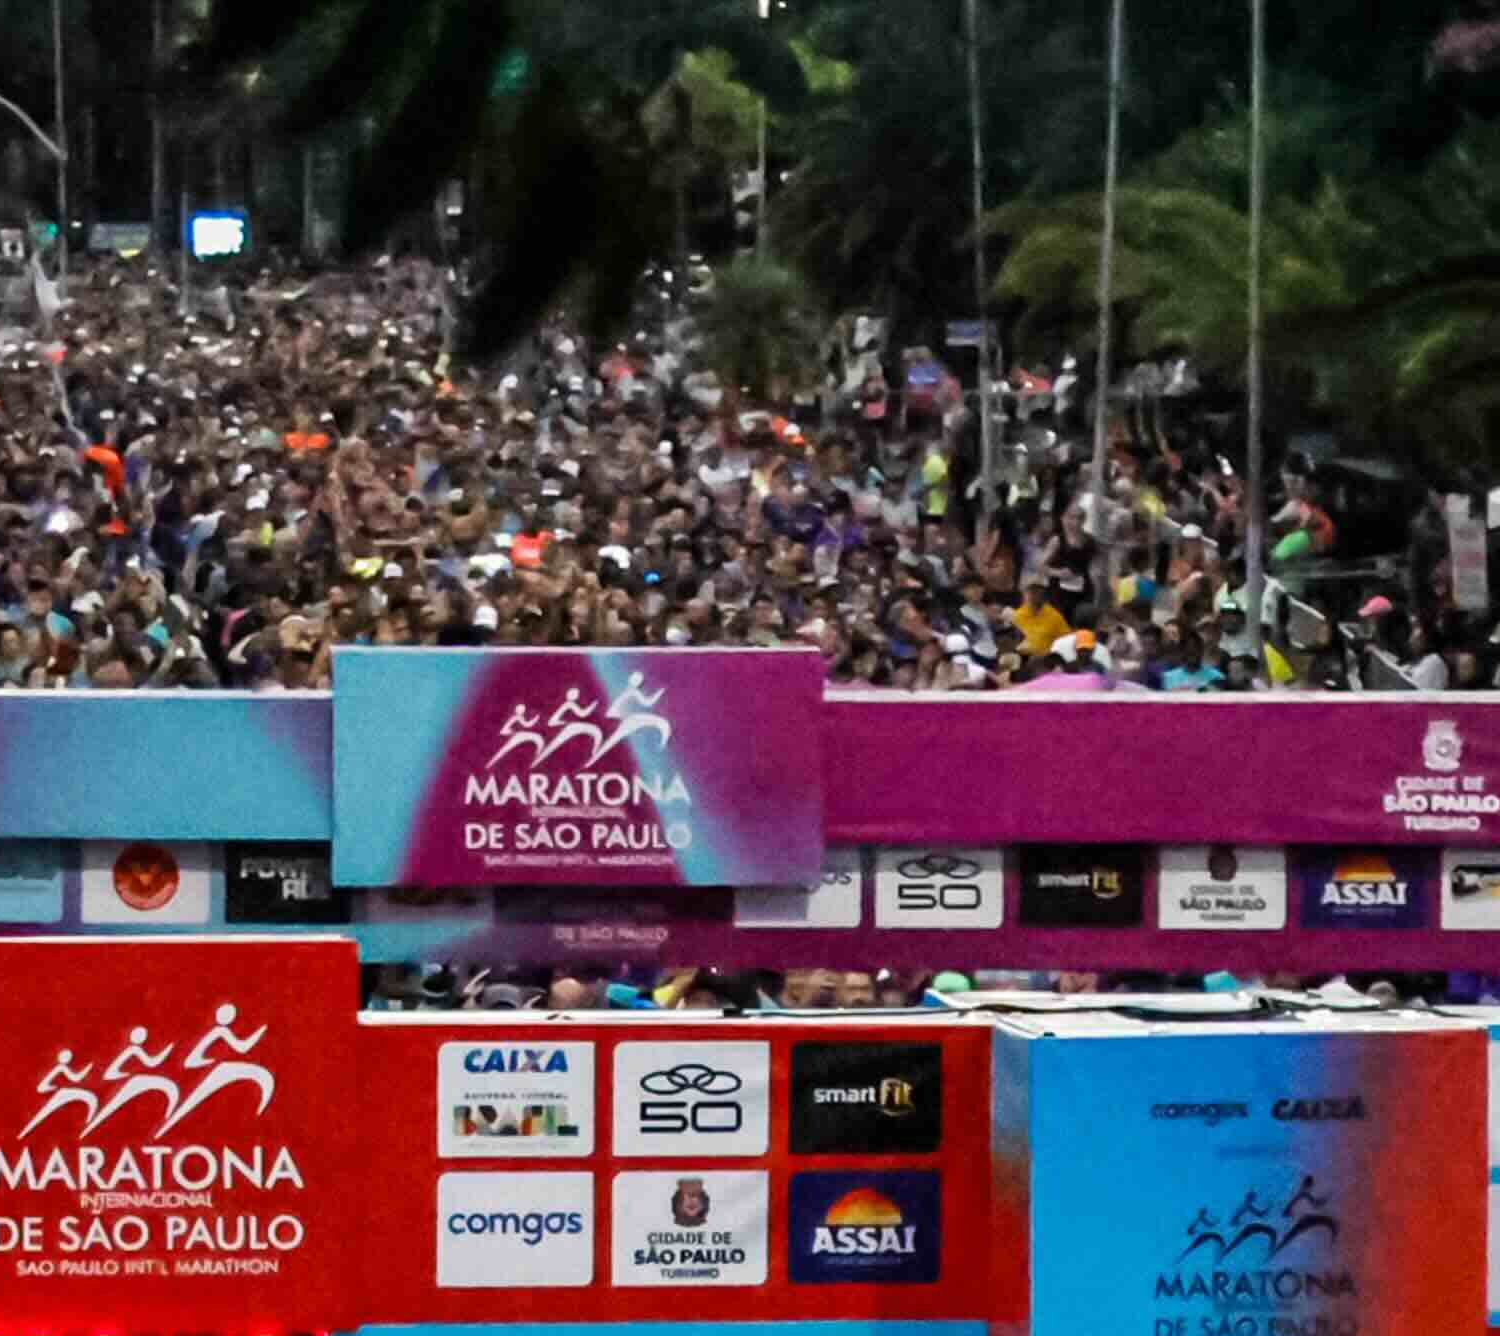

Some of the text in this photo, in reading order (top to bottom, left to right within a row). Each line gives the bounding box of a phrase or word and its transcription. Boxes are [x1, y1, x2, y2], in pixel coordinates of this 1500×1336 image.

[464, 773, 691, 805] MARATONA
[465, 817, 692, 849] DE SÃO PAULO
[897, 883, 981, 910] 50
[464, 1048, 568, 1073] CAIXA
[813, 1085, 876, 1105] smart
[640, 1101, 742, 1133] 50
[80, 1193, 214, 1209] INTERNACIONAL
[58, 1204, 149, 1252] SÃO
[165, 1216, 305, 1252] PAULO
[711, 1231, 732, 1246] DE
[16, 1259, 55, 1276] SAO
[59, 1259, 119, 1276] PAULO
[175, 1259, 279, 1276] MARATHON
[633, 1245, 747, 1266] SÃO PAULO
[1155, 1269, 1358, 1299] MARATONA
